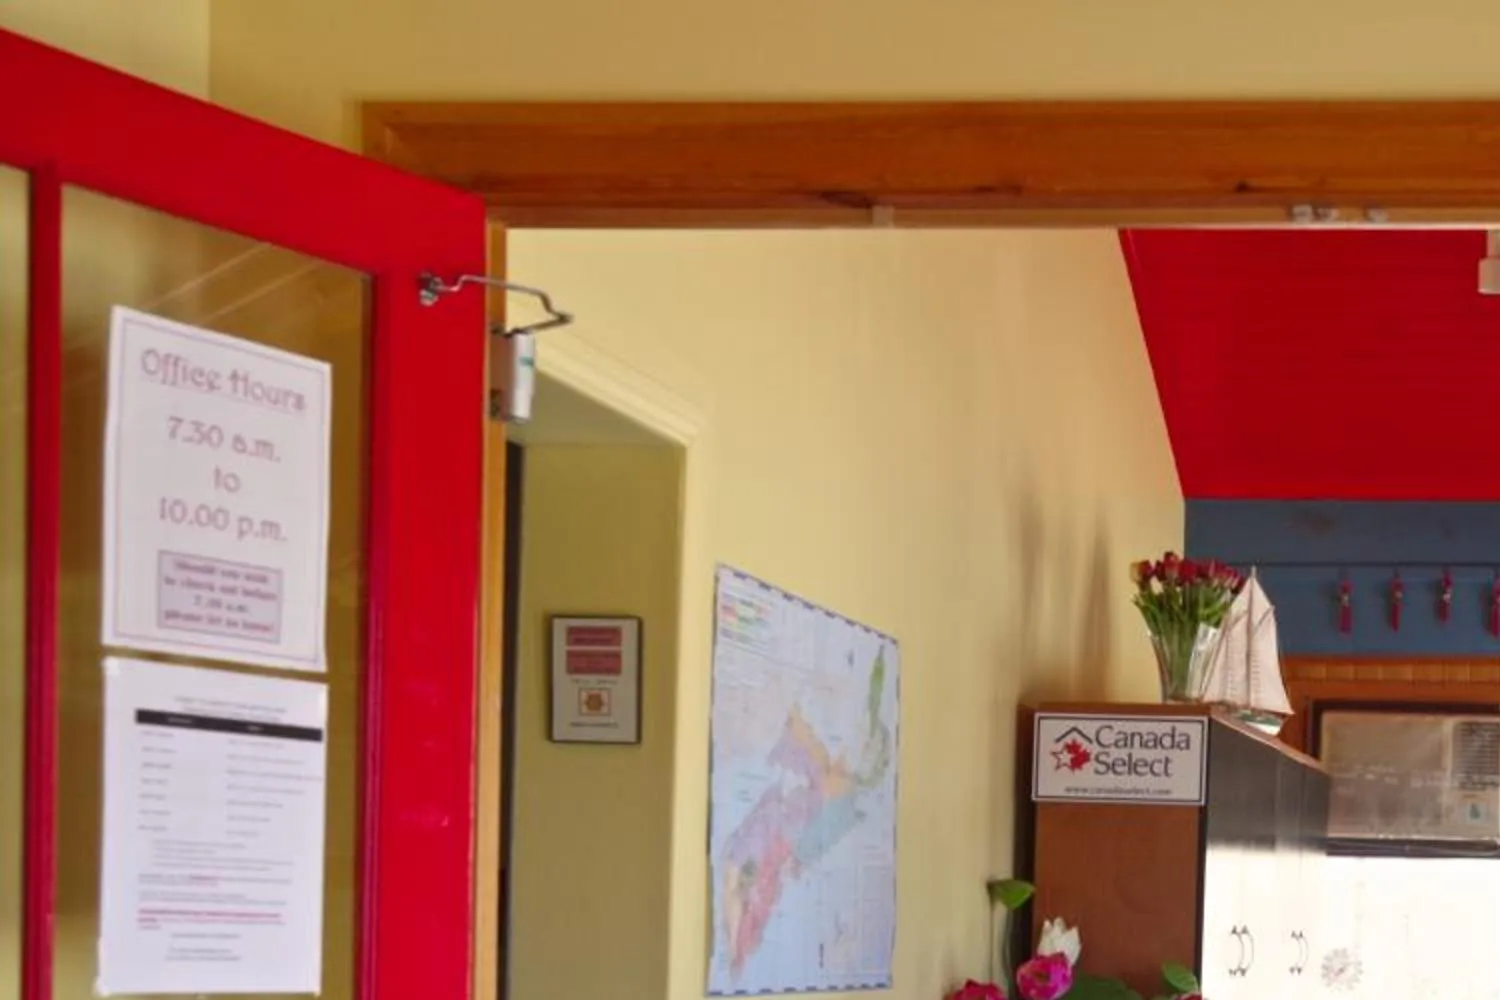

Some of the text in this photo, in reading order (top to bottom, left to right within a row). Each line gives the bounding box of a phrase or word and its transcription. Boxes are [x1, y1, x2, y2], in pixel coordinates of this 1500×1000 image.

[141, 348, 307, 412] Office Hours
[166, 415, 282, 462] 7.30 a.m.
[212, 465, 242, 493] to
[158, 496, 288, 542] 10.00 p.m.
[1095, 724, 1191, 751] Canada
[1093, 752, 1173, 777] Select
